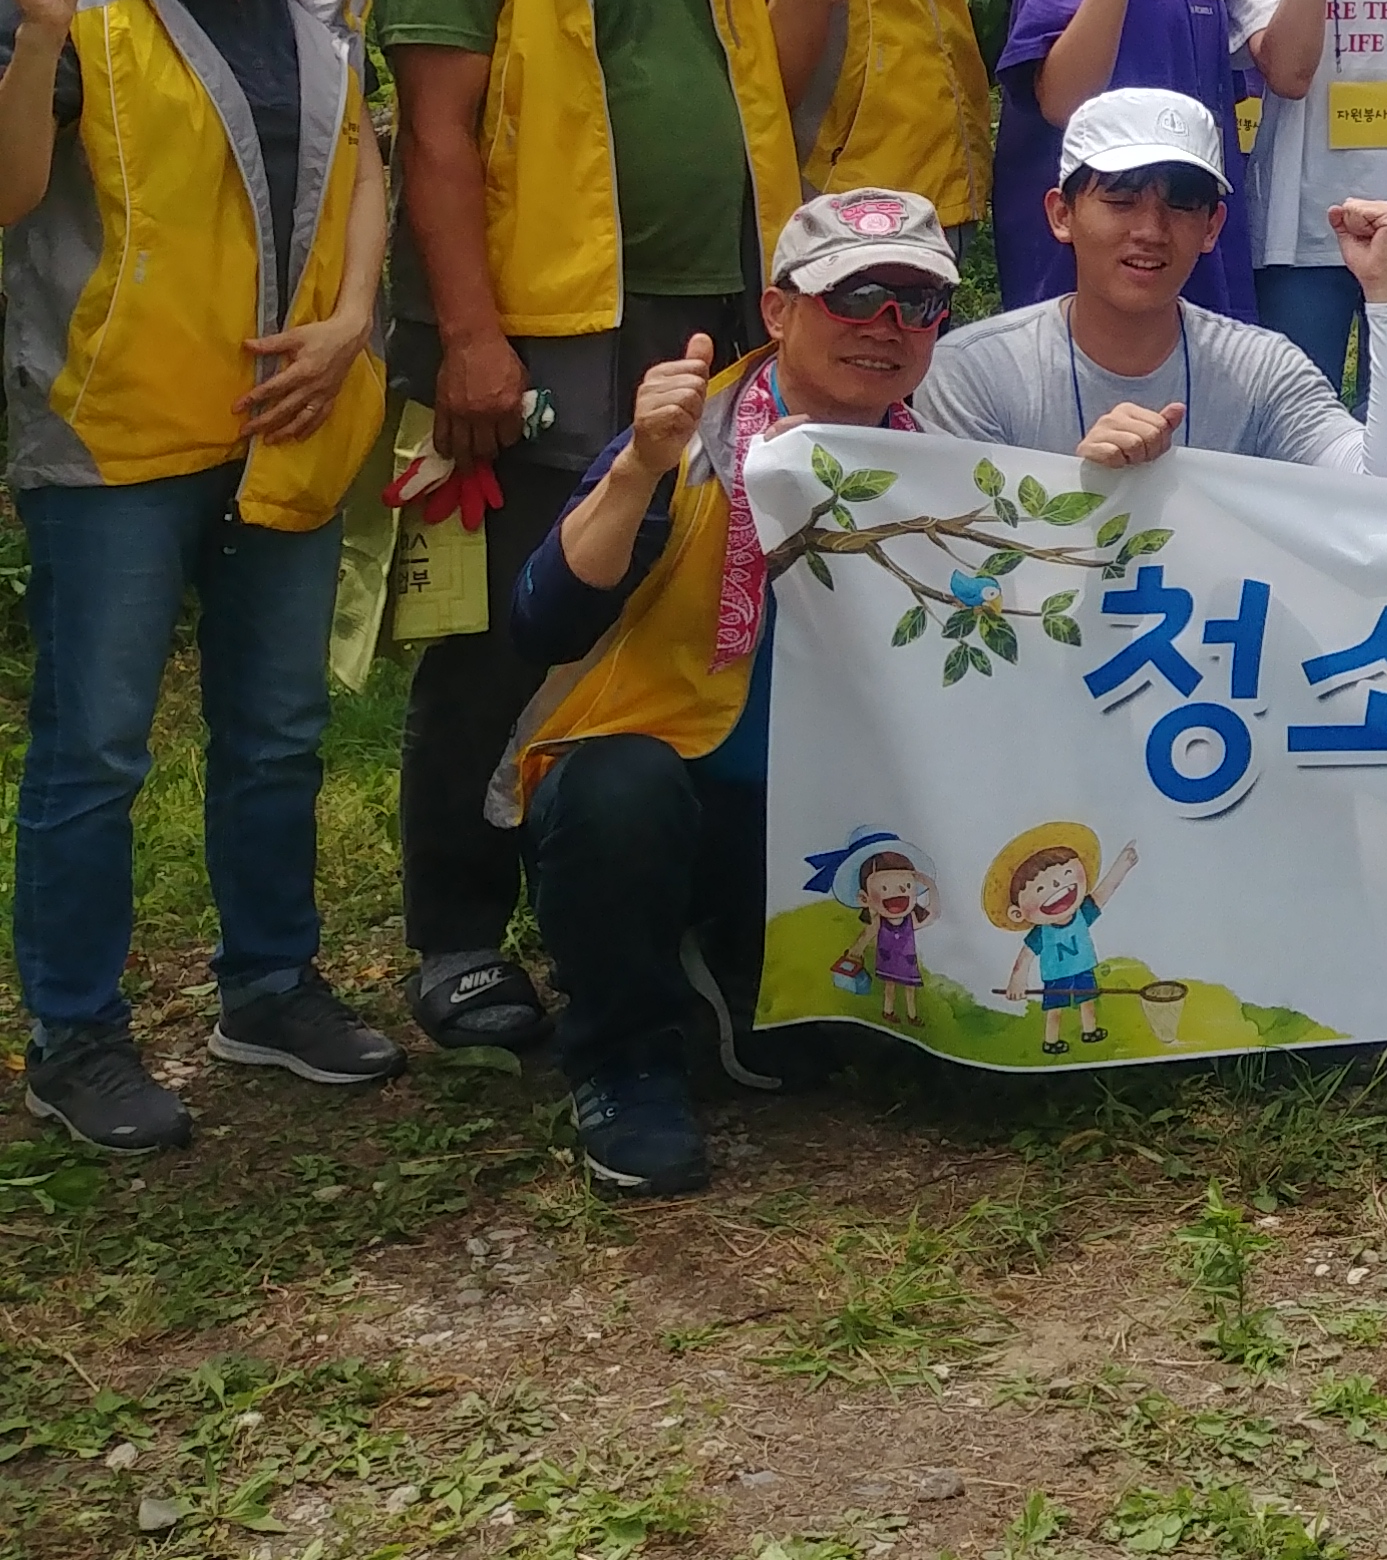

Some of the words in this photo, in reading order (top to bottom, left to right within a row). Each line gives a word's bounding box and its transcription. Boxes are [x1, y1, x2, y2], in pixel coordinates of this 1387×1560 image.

[1325, 1, 1357, 20] RE
[1334, 33, 1385, 53] LIFE
[459, 966, 503, 992] NIKE
